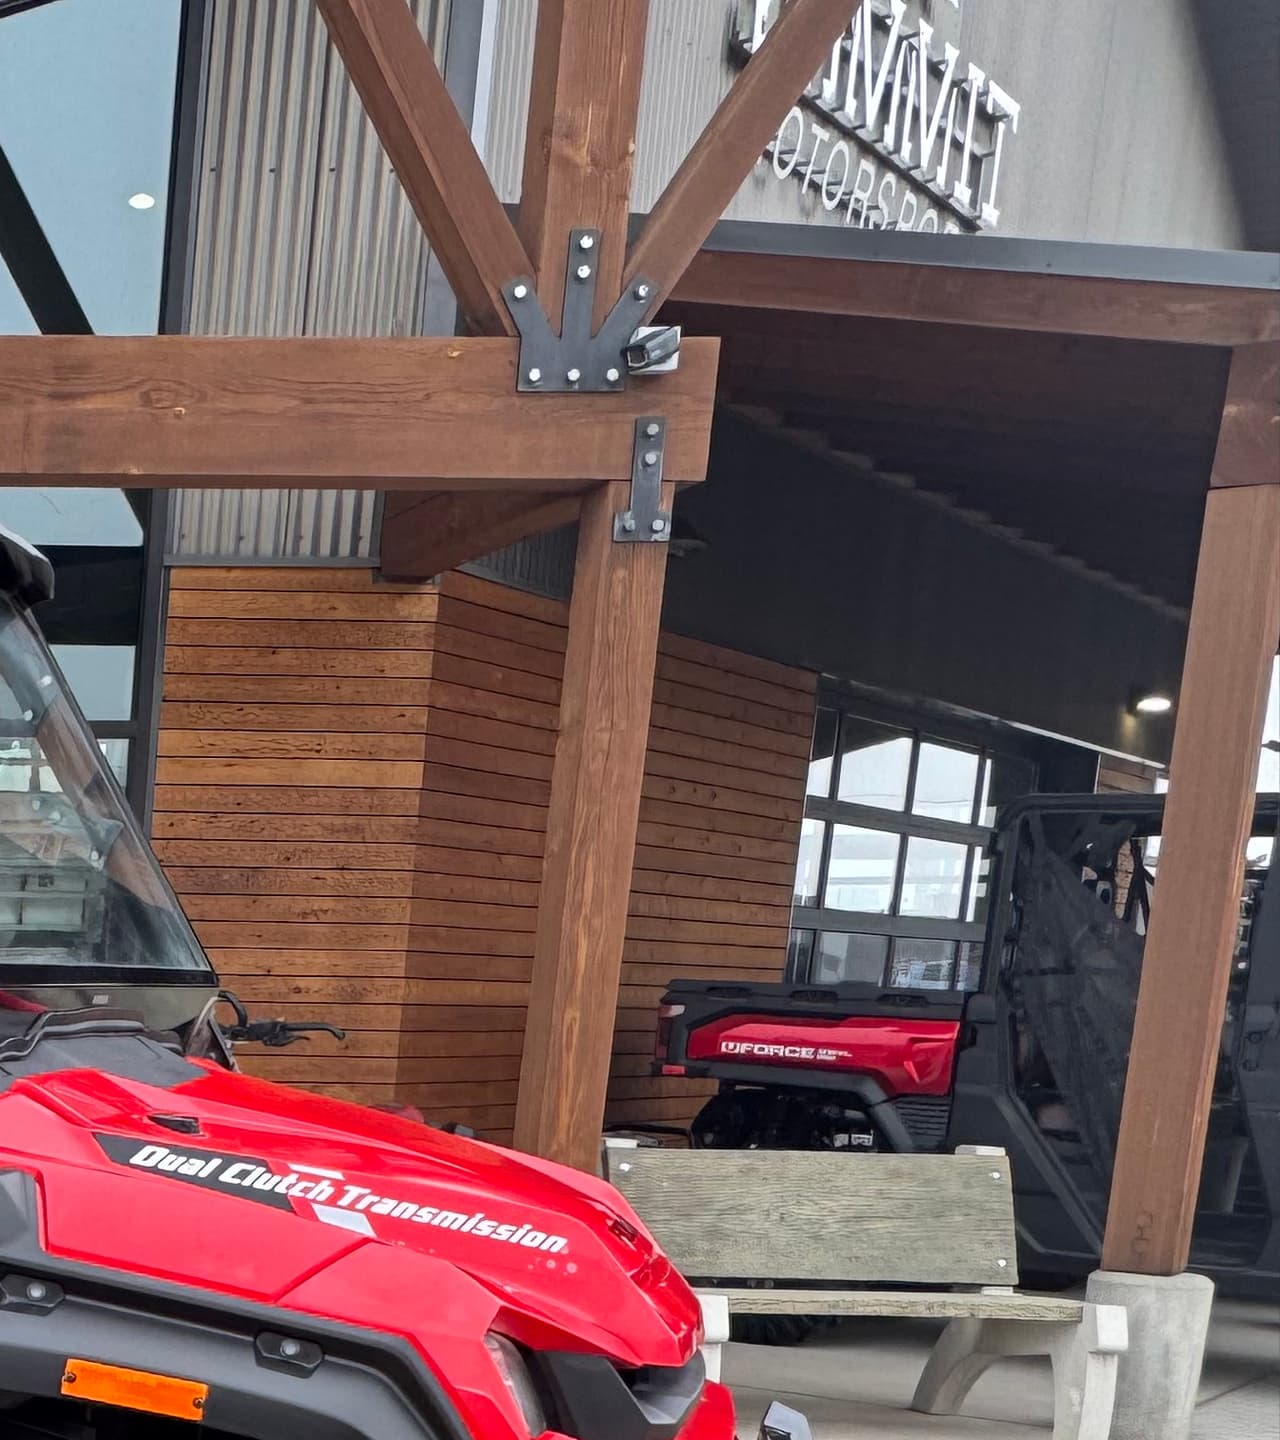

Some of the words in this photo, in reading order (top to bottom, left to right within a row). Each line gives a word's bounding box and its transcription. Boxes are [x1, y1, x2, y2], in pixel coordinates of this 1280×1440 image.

[750, 0, 1021, 227] MMIT
[756, 106, 960, 234] OTORSP
[128, 1144, 222, 1179] Dual
[218, 1160, 335, 1203] Clutch
[336, 1184, 569, 1254] Transmission
